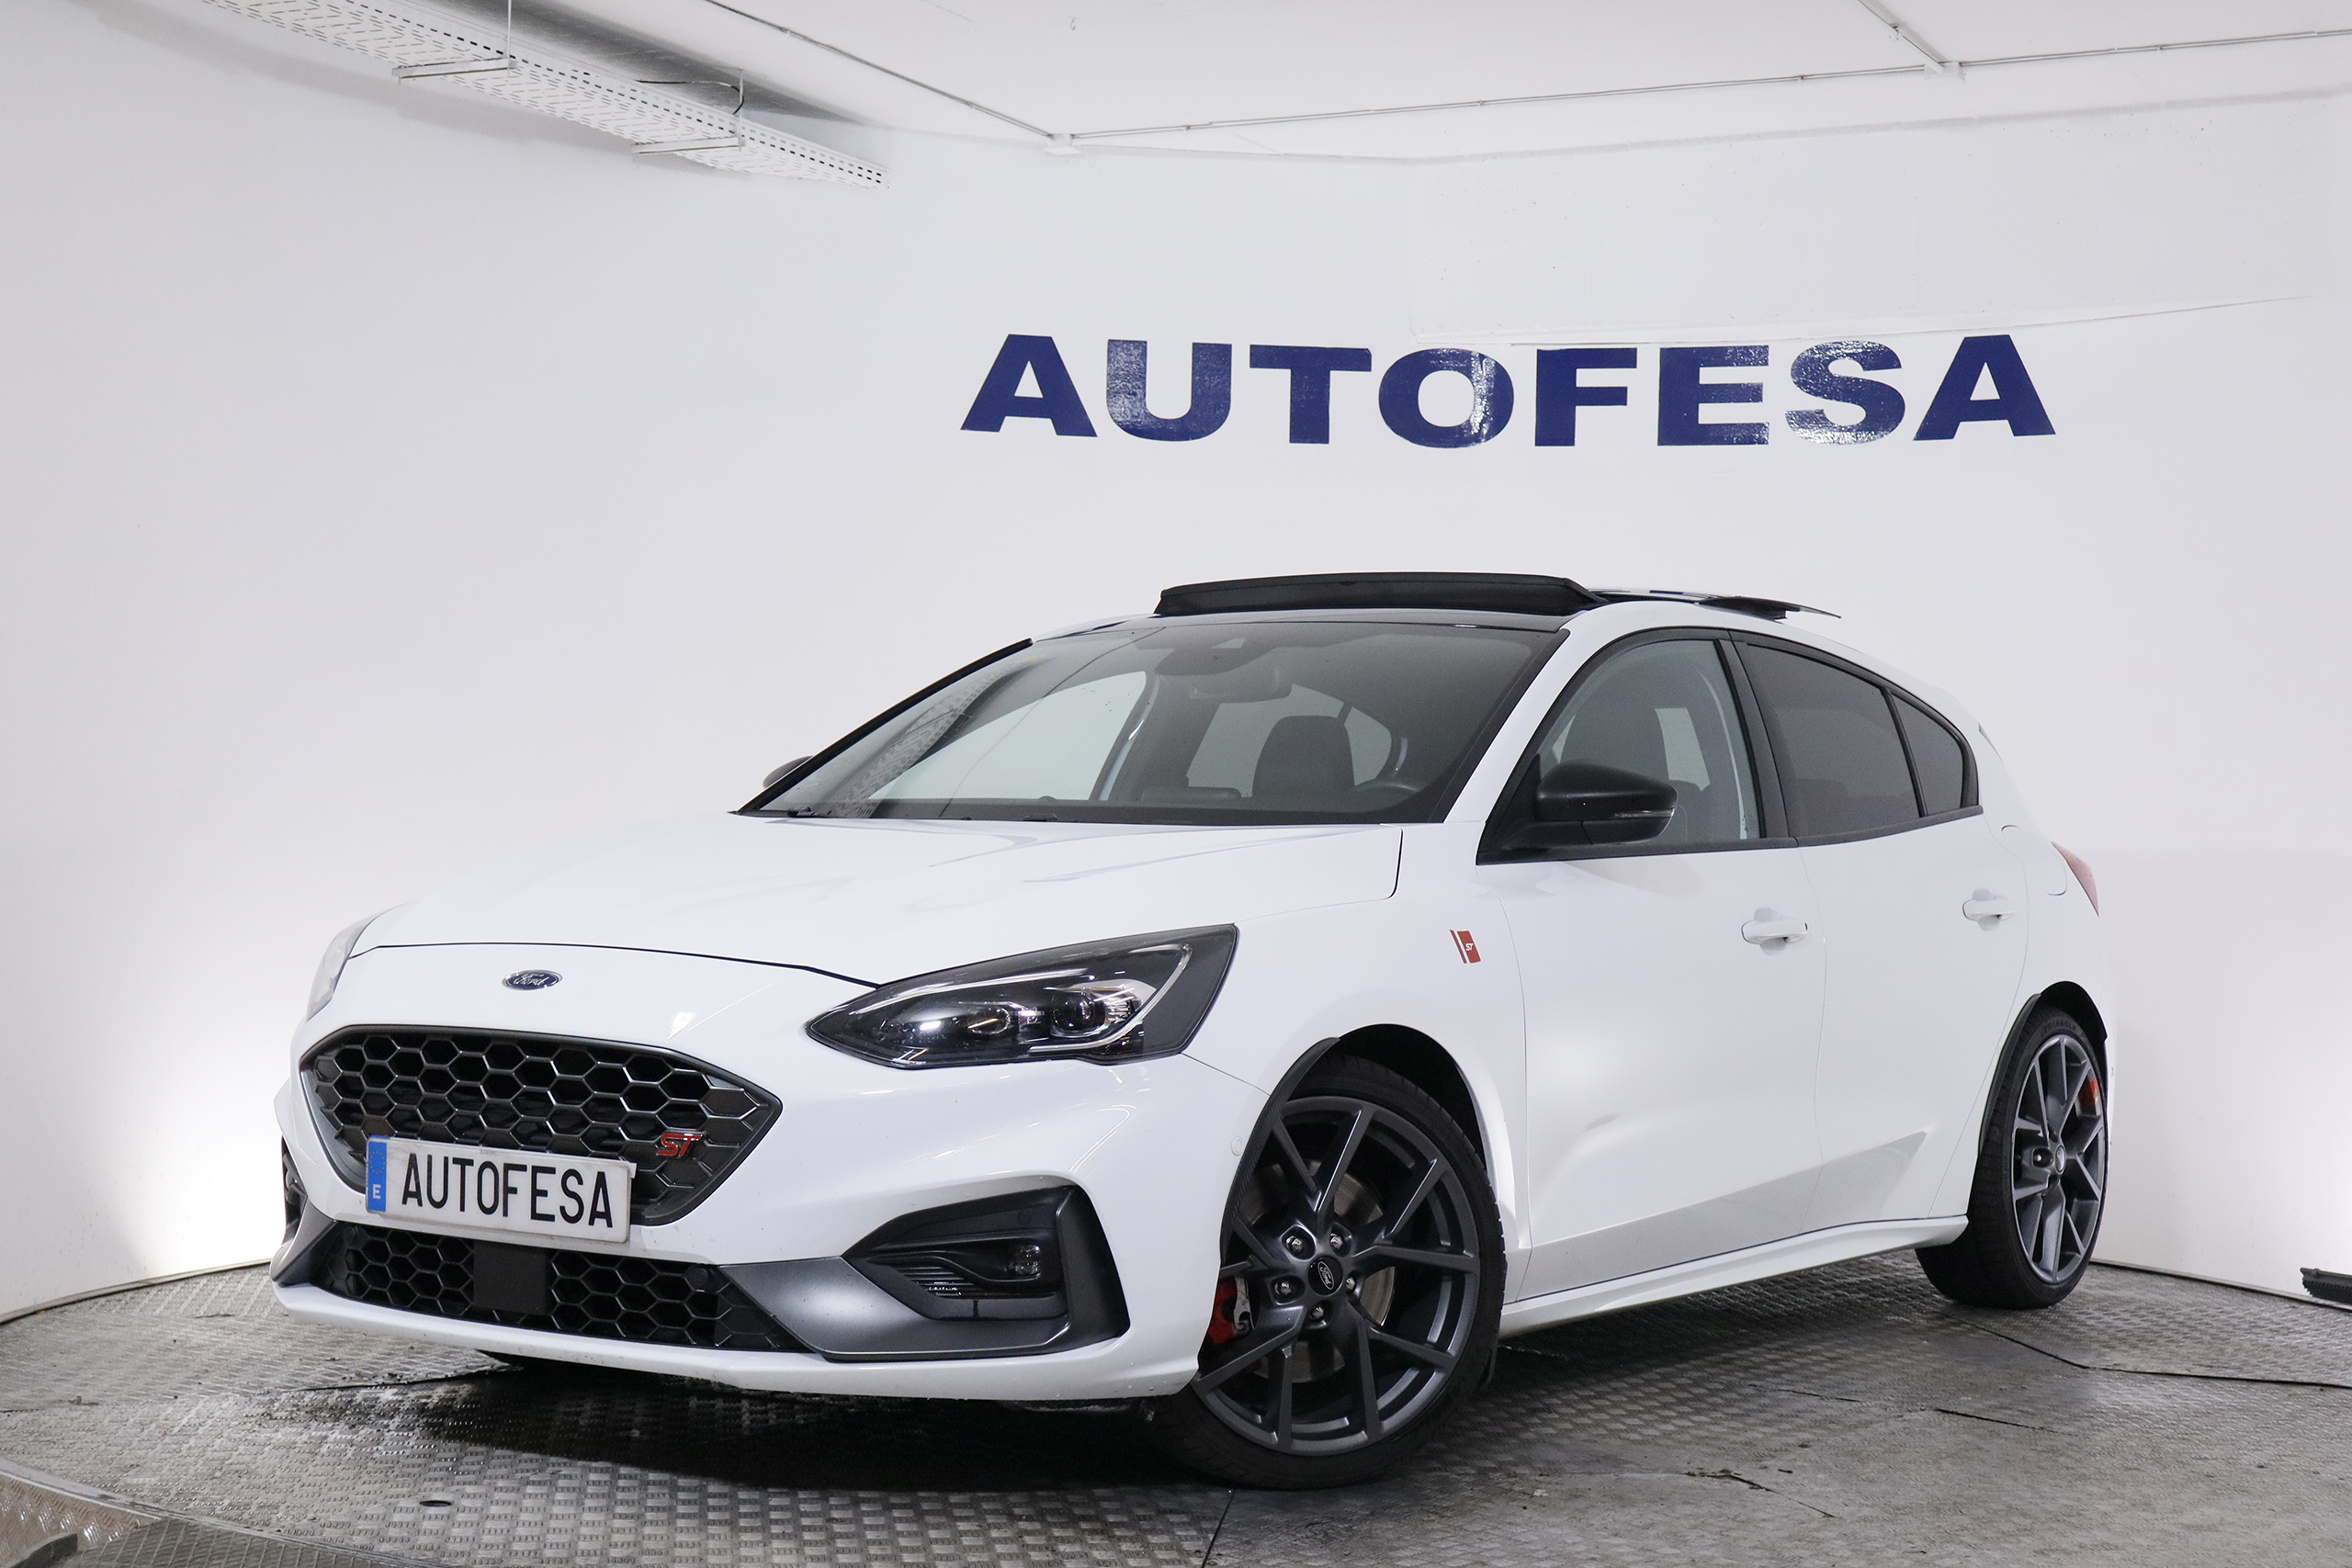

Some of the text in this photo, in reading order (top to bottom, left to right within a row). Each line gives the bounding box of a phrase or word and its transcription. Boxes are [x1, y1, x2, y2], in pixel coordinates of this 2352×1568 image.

[960, 333, 2056, 448] AUTOFESA
[1464, 942, 1475, 952] ST
[656, 1132, 704, 1158] ST
[372, 1184, 381, 1200] E
[401, 1152, 614, 1229] AUTOFESA
